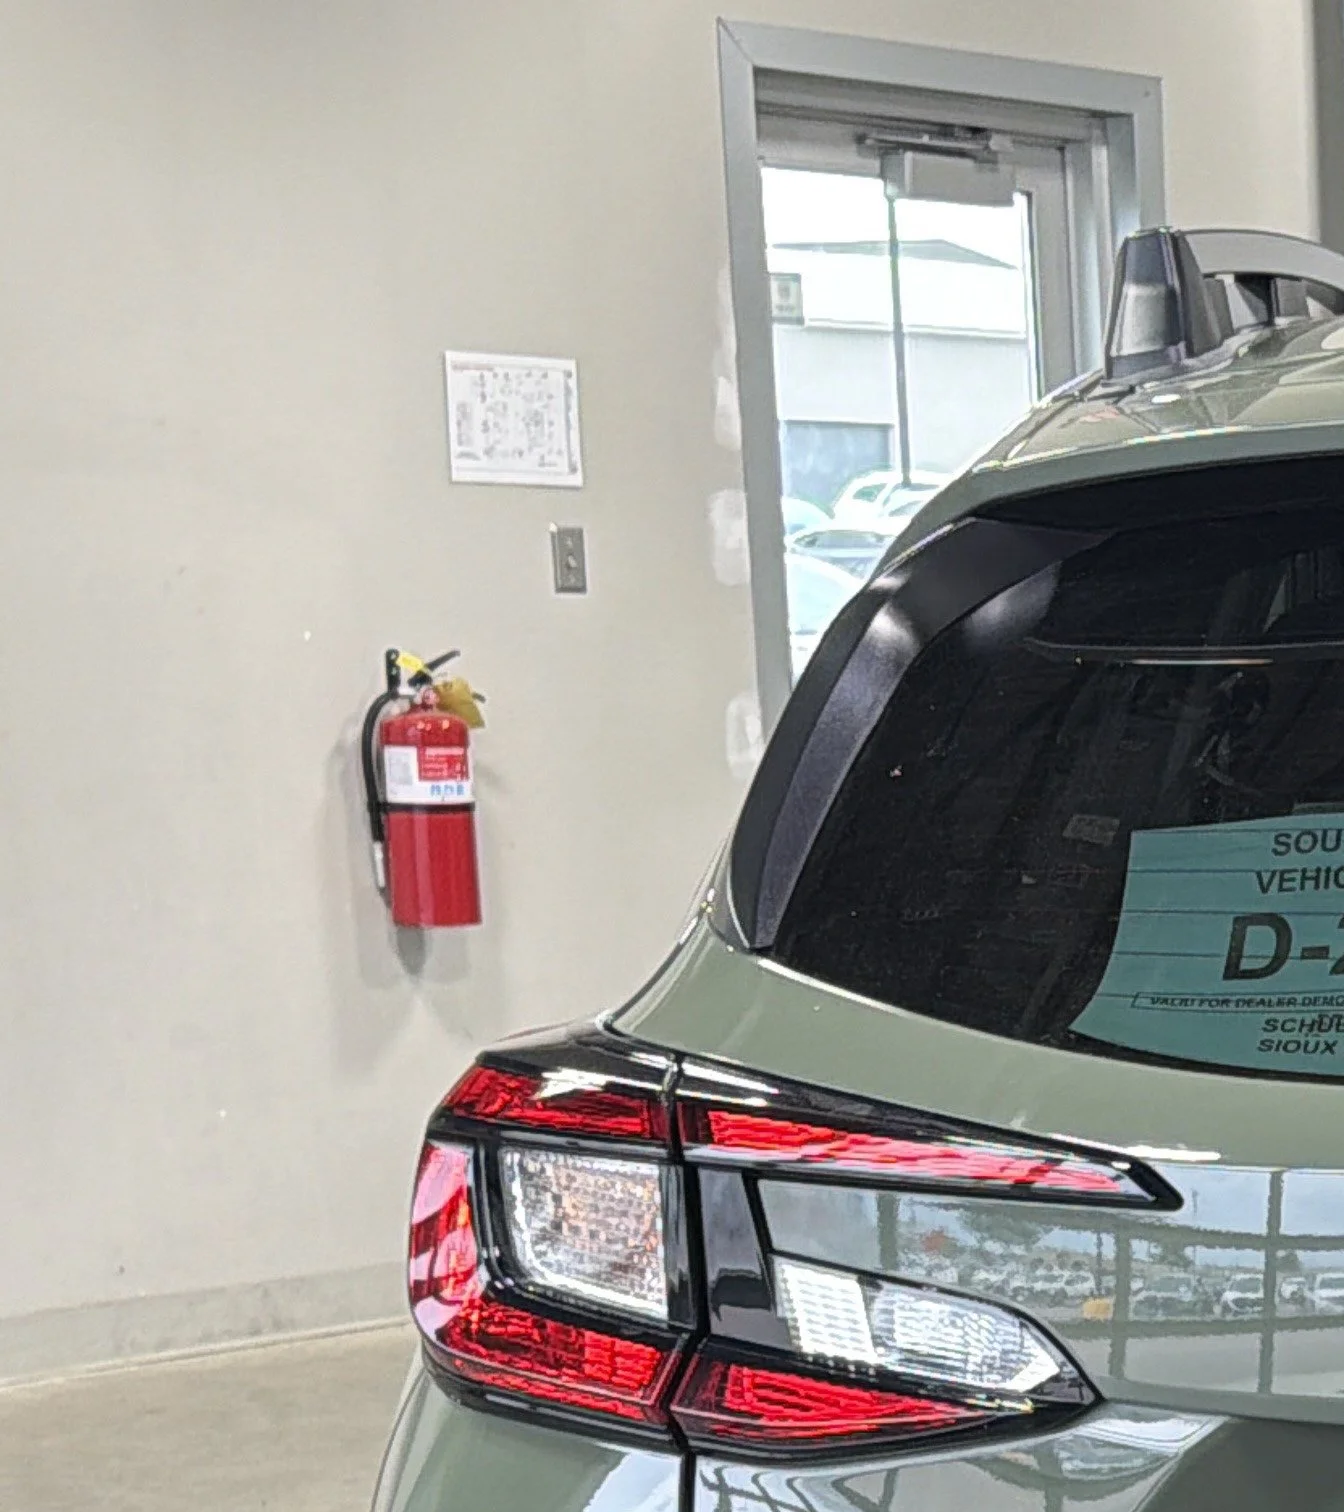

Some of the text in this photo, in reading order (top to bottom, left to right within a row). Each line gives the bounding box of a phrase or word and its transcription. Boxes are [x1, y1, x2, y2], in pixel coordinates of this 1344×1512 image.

[1199, 997, 1231, 1008] FOR
[1234, 995, 1299, 1009] DEALER
[1257, 1038, 1338, 1056] SIOUX
